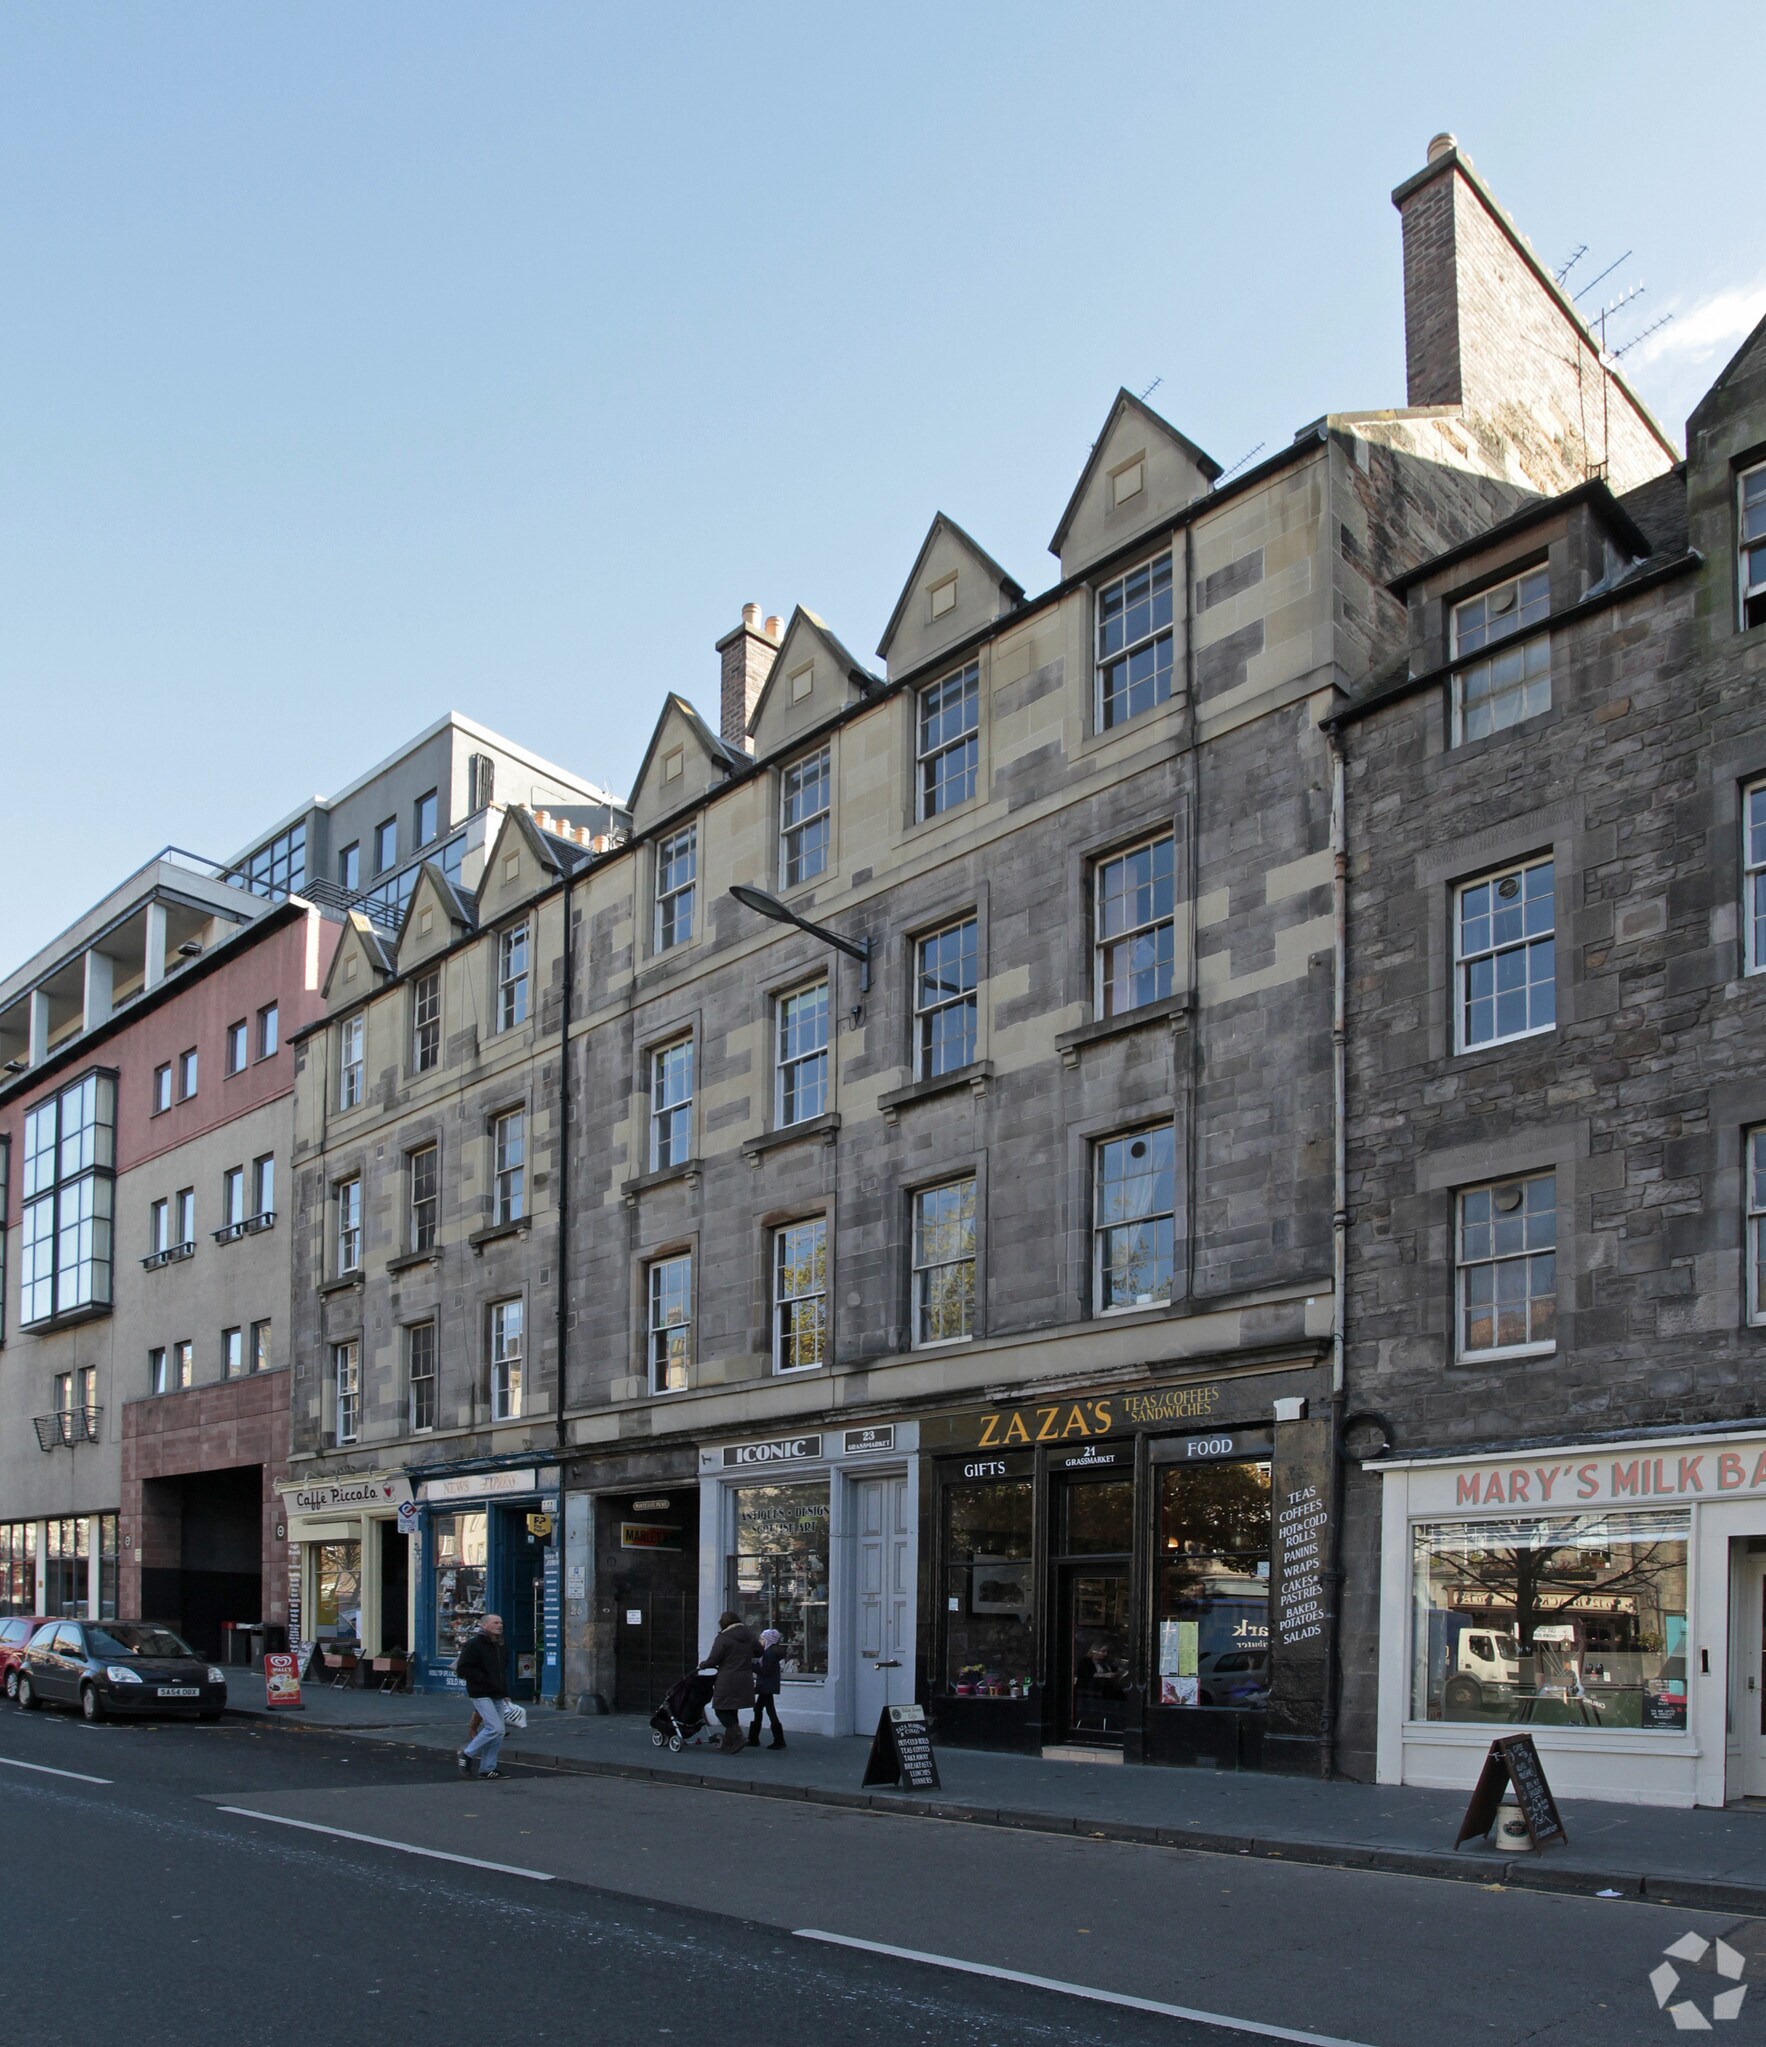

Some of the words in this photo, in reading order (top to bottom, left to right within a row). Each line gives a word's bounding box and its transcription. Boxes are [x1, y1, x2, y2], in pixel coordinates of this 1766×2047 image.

[1131, 1400, 1212, 1423] SANDWICHES
[977, 1400, 1112, 1447] ZAZA'S
[847, 1439, 891, 1451] GRASSMARKET
[862, 1430, 875, 1442] 23
[736, 1440, 806, 1464] ICONIC
[1083, 1446, 1096, 1457] 21
[1187, 1438, 1233, 1457] FOOD
[964, 1460, 1006, 1478] GIFTS
[1065, 1454, 1116, 1467] GRASSMARKET
[443, 1480, 470, 1495] NEWS
[1456, 1463, 1600, 1506] MARY'S
[1611, 1455, 1704, 1498] MILK
[330, 1485, 378, 1503] Piccolo
[1287, 1485, 1317, 1505] TEAS
[741, 1507, 784, 1521] ANTIQUES
[795, 1504, 830, 1519] DESIGN
[1279, 1499, 1323, 1523] COFFEES
[799, 1521, 817, 1533] ART
[1286, 1528, 1316, 1548] ROLLS
[1283, 1542, 1319, 1564] PANINIS
[1283, 1557, 1320, 1578] WRAPS
[1280, 1584, 1323, 1607] PASTRIES
[1286, 1600, 1318, 1619] BAKED
[1279, 1609, 1325, 1632] POTATOES
[1283, 1624, 1322, 1645] SALADS
